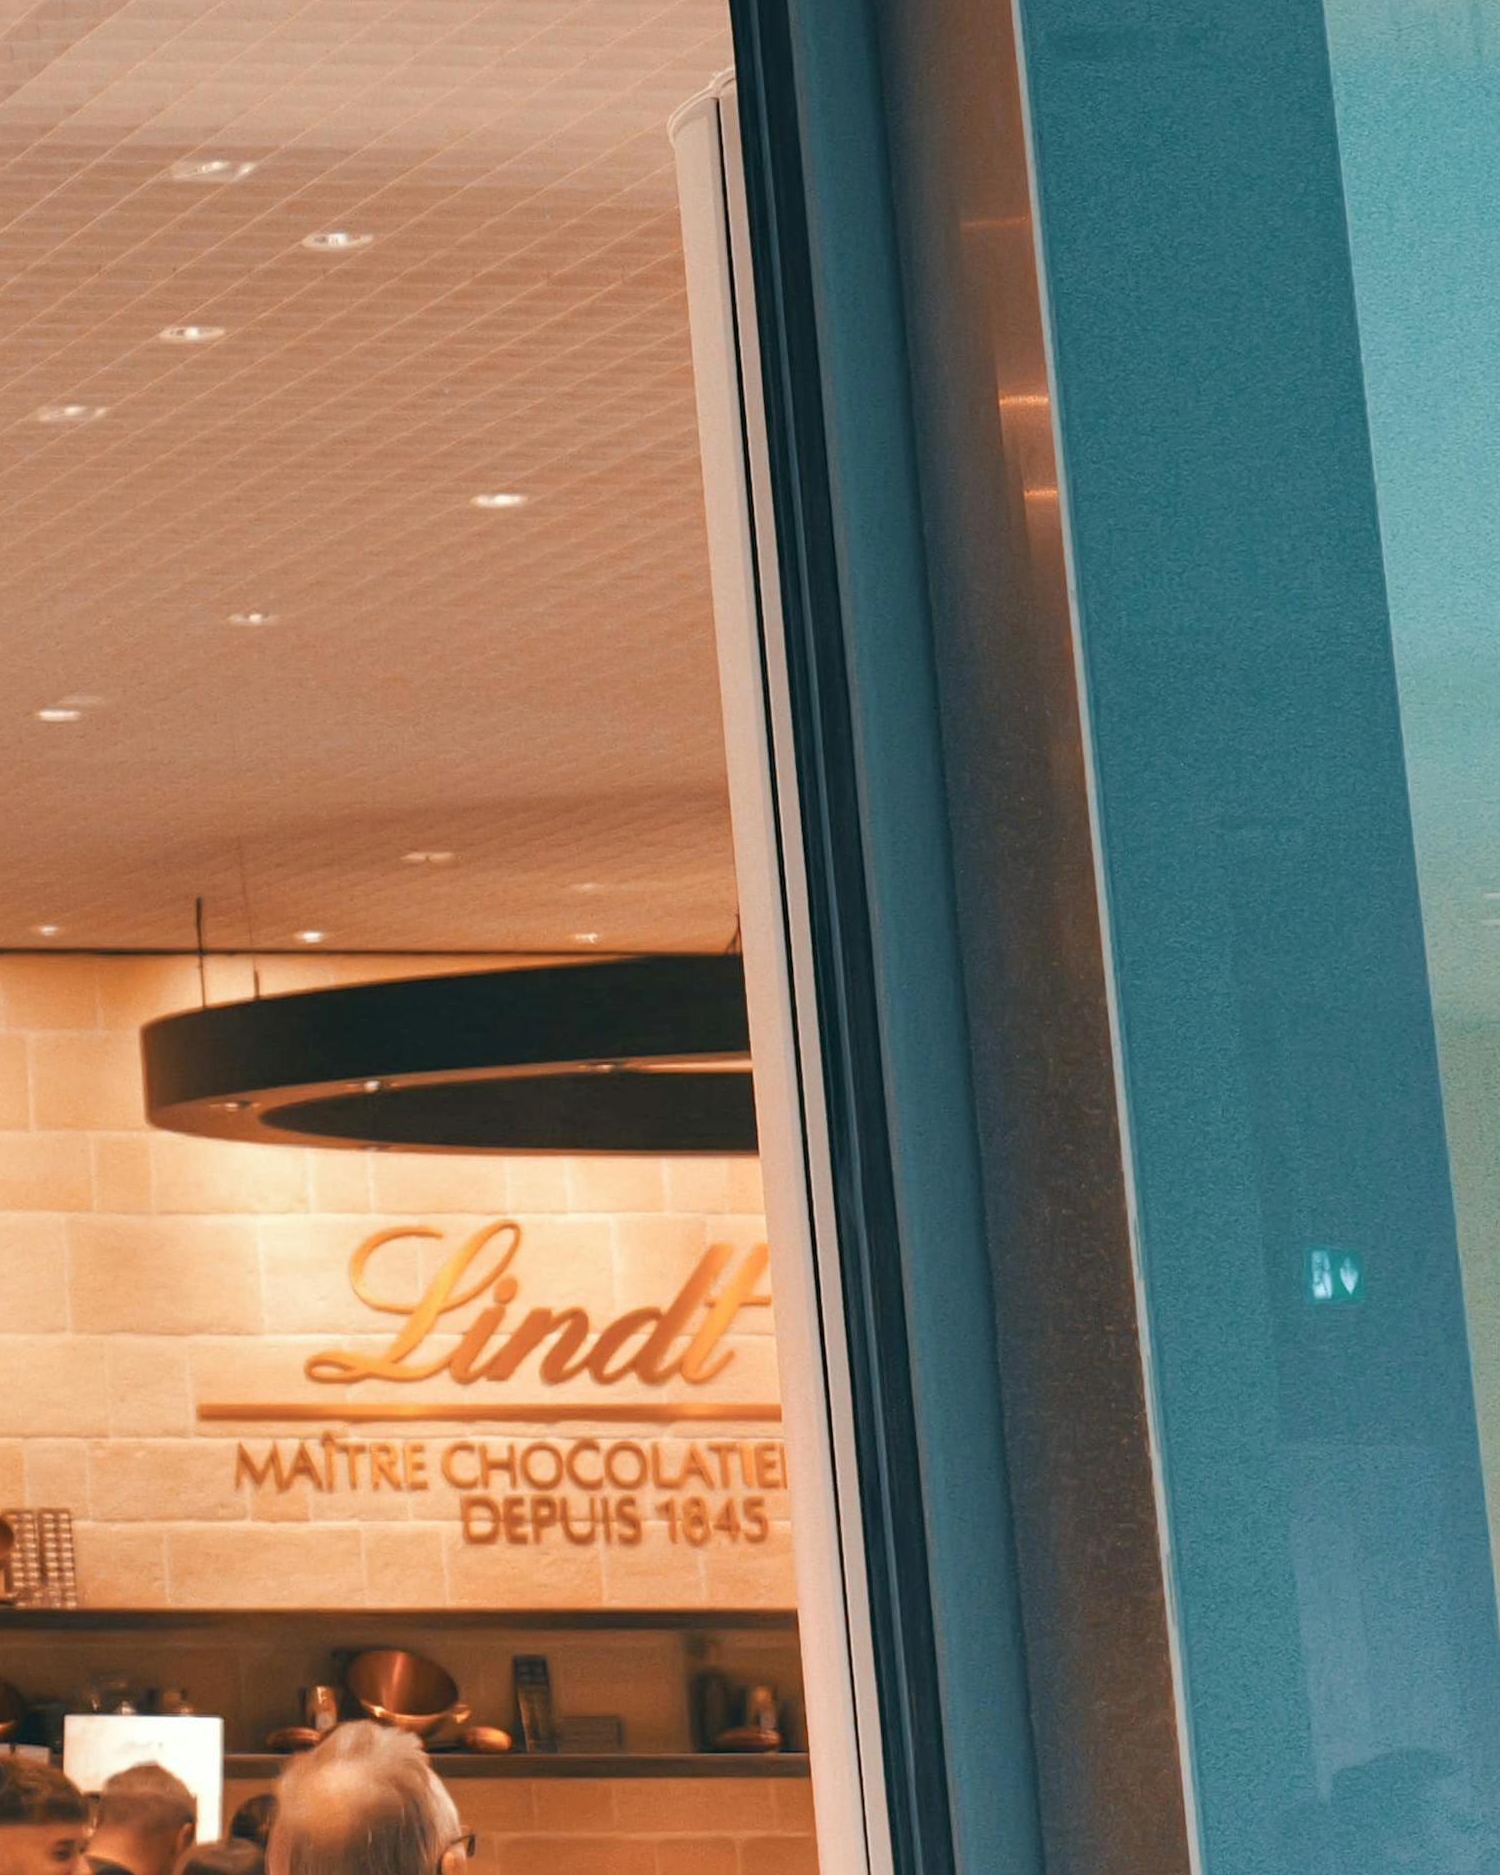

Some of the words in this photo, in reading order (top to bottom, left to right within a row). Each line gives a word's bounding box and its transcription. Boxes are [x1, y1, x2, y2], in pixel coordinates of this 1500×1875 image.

[304, 1219, 773, 1385] Lindt
[234, 1431, 428, 1492] MAÎTRE
[442, 1439, 788, 1491] CHOCOLATIE
[461, 1495, 642, 1545] DEPUIS
[656, 1495, 770, 1544] 1845
